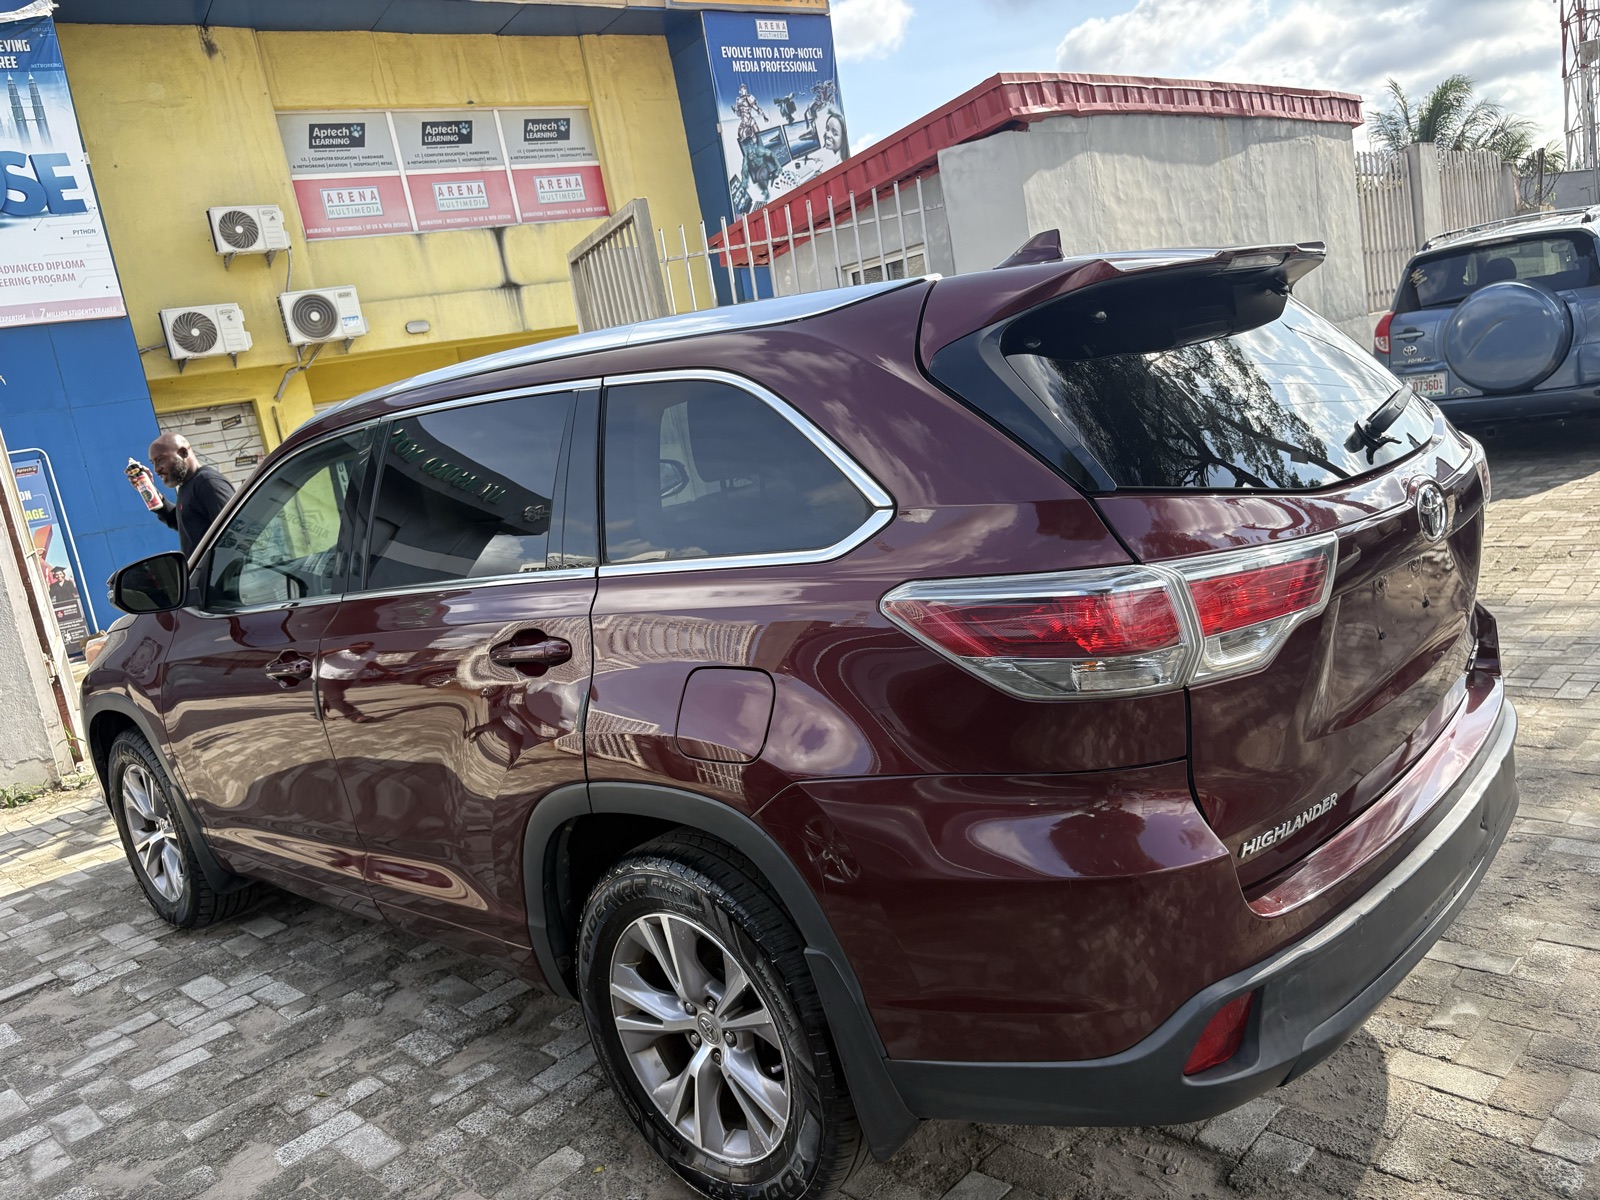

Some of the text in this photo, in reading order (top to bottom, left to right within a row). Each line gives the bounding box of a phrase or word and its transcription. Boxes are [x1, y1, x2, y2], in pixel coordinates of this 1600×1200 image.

[758, 22, 786, 30] ARENA
[721, 46, 823, 59] EVOLVE INTO A TOP-NOTCH
[732, 61, 817, 72] MEDIA PROFESSIONAL
[313, 126, 349, 138] Aptech
[425, 125, 458, 135] Aptech
[527, 122, 557, 132] Aptech
[0, 150, 88, 216] SE
[539, 178, 581, 190] ARENA
[438, 184, 484, 197] ARENA
[326, 190, 378, 204] ARENA
[440, 199, 487, 208] MULTIMEDIA
[328, 206, 381, 216] MULTIMEDIA
[0, 260, 86, 275] ADVANCED DIPLOMA
[32, 273, 76, 284] PROGRAM
[1239, 792, 1338, 858] HIGHLANDER
